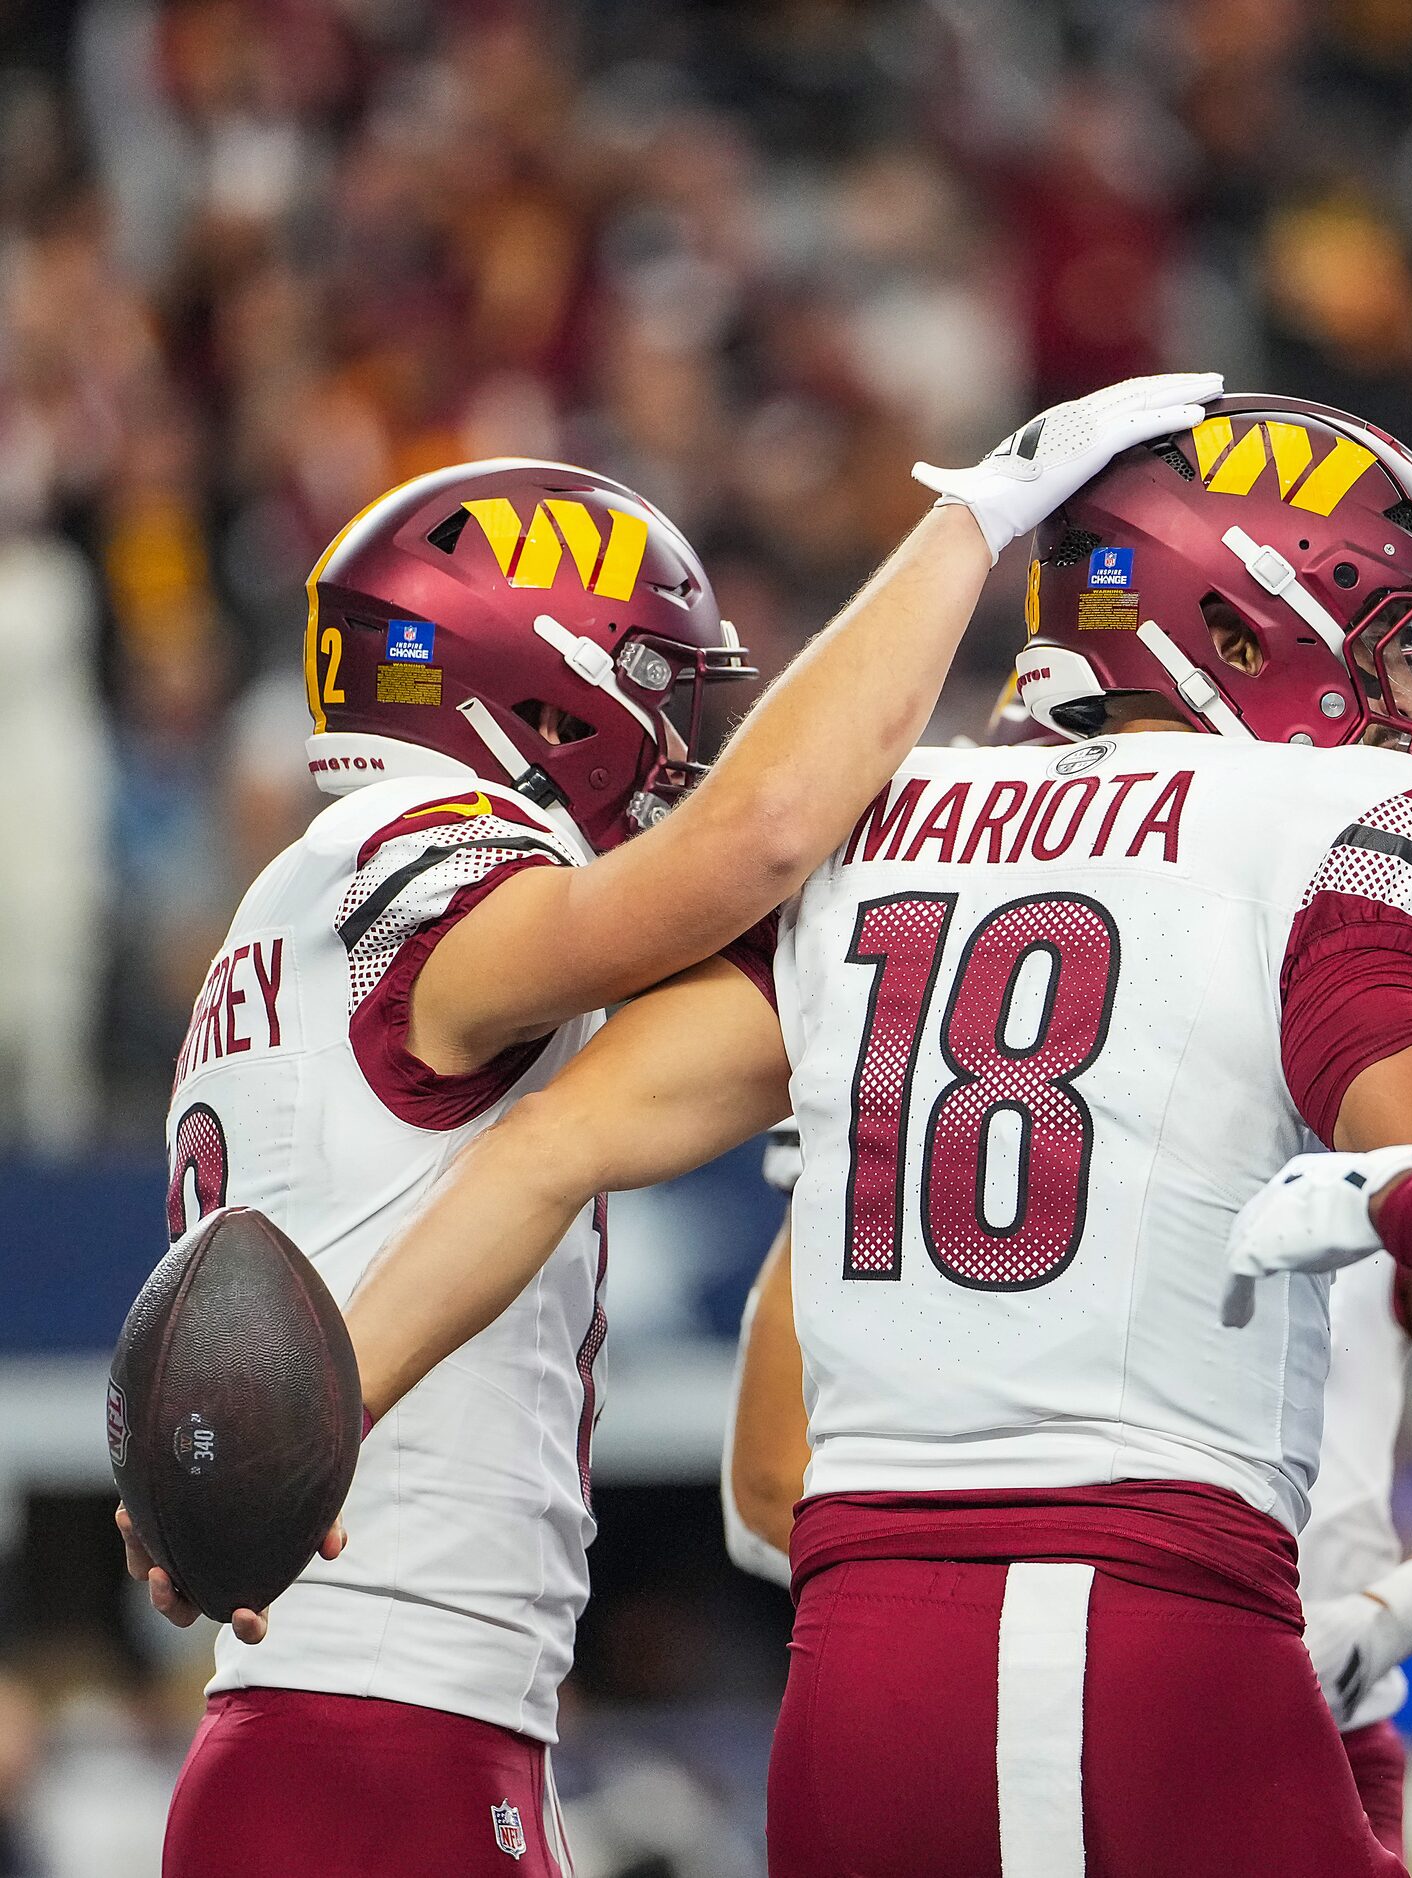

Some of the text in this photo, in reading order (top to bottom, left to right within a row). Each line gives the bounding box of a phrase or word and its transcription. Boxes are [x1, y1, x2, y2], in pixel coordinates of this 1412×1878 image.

[1192, 406, 1378, 517] W
[461, 498, 648, 602] W
[1091, 575, 1128, 585] CHANGE
[389, 647, 430, 660] CHANGE
[395, 641, 423, 650] INSPIRE
[842, 770, 1197, 866] MARIOTA
[842, 891, 1121, 1294] 18
[193, 1429, 215, 1461] 340
[500, 1825, 522, 1849] NFL
